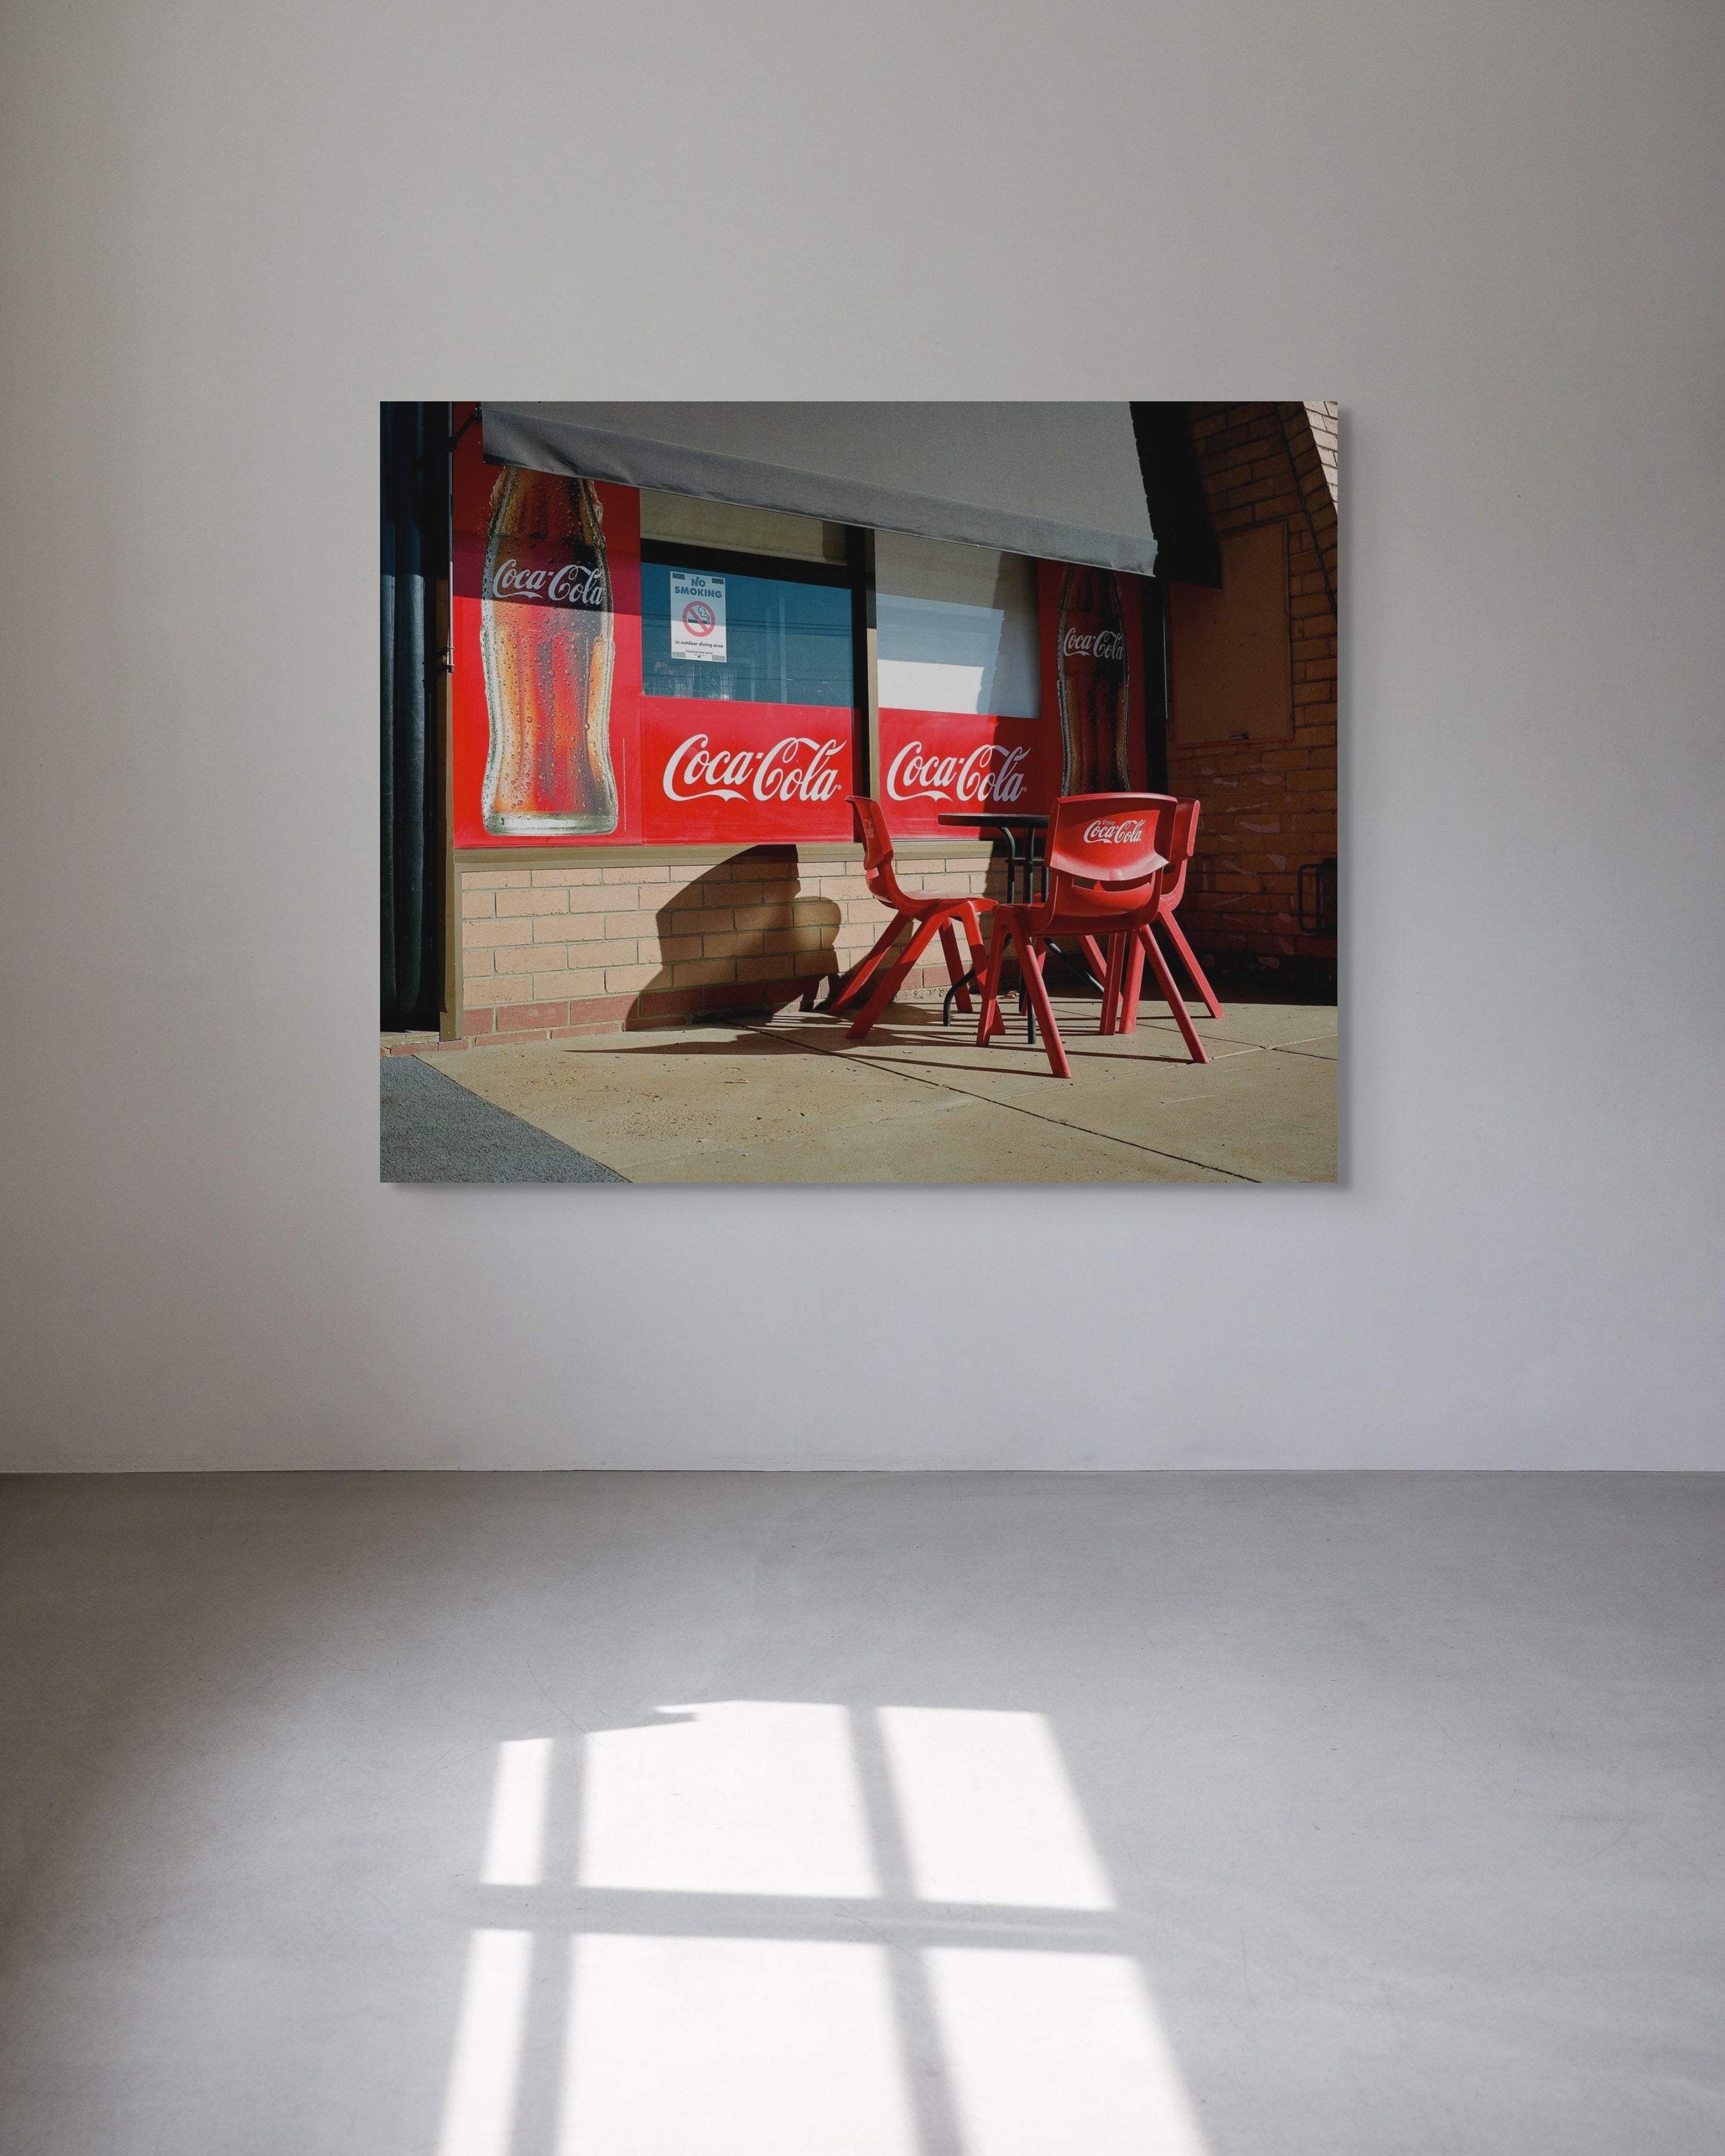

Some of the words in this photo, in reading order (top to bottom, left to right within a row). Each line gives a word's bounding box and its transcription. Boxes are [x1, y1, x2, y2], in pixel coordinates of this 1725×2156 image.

[493, 559, 603, 606] Coca-Cola
[674, 586, 723, 599] SMOKING
[691, 578, 706, 588] NO
[1063, 627, 1123, 660] Coca-Cola
[662, 733, 848, 802] Coca-Cola
[886, 741, 1031, 803] Coca-Cola
[1083, 819, 1147, 844] Coca-Cola
